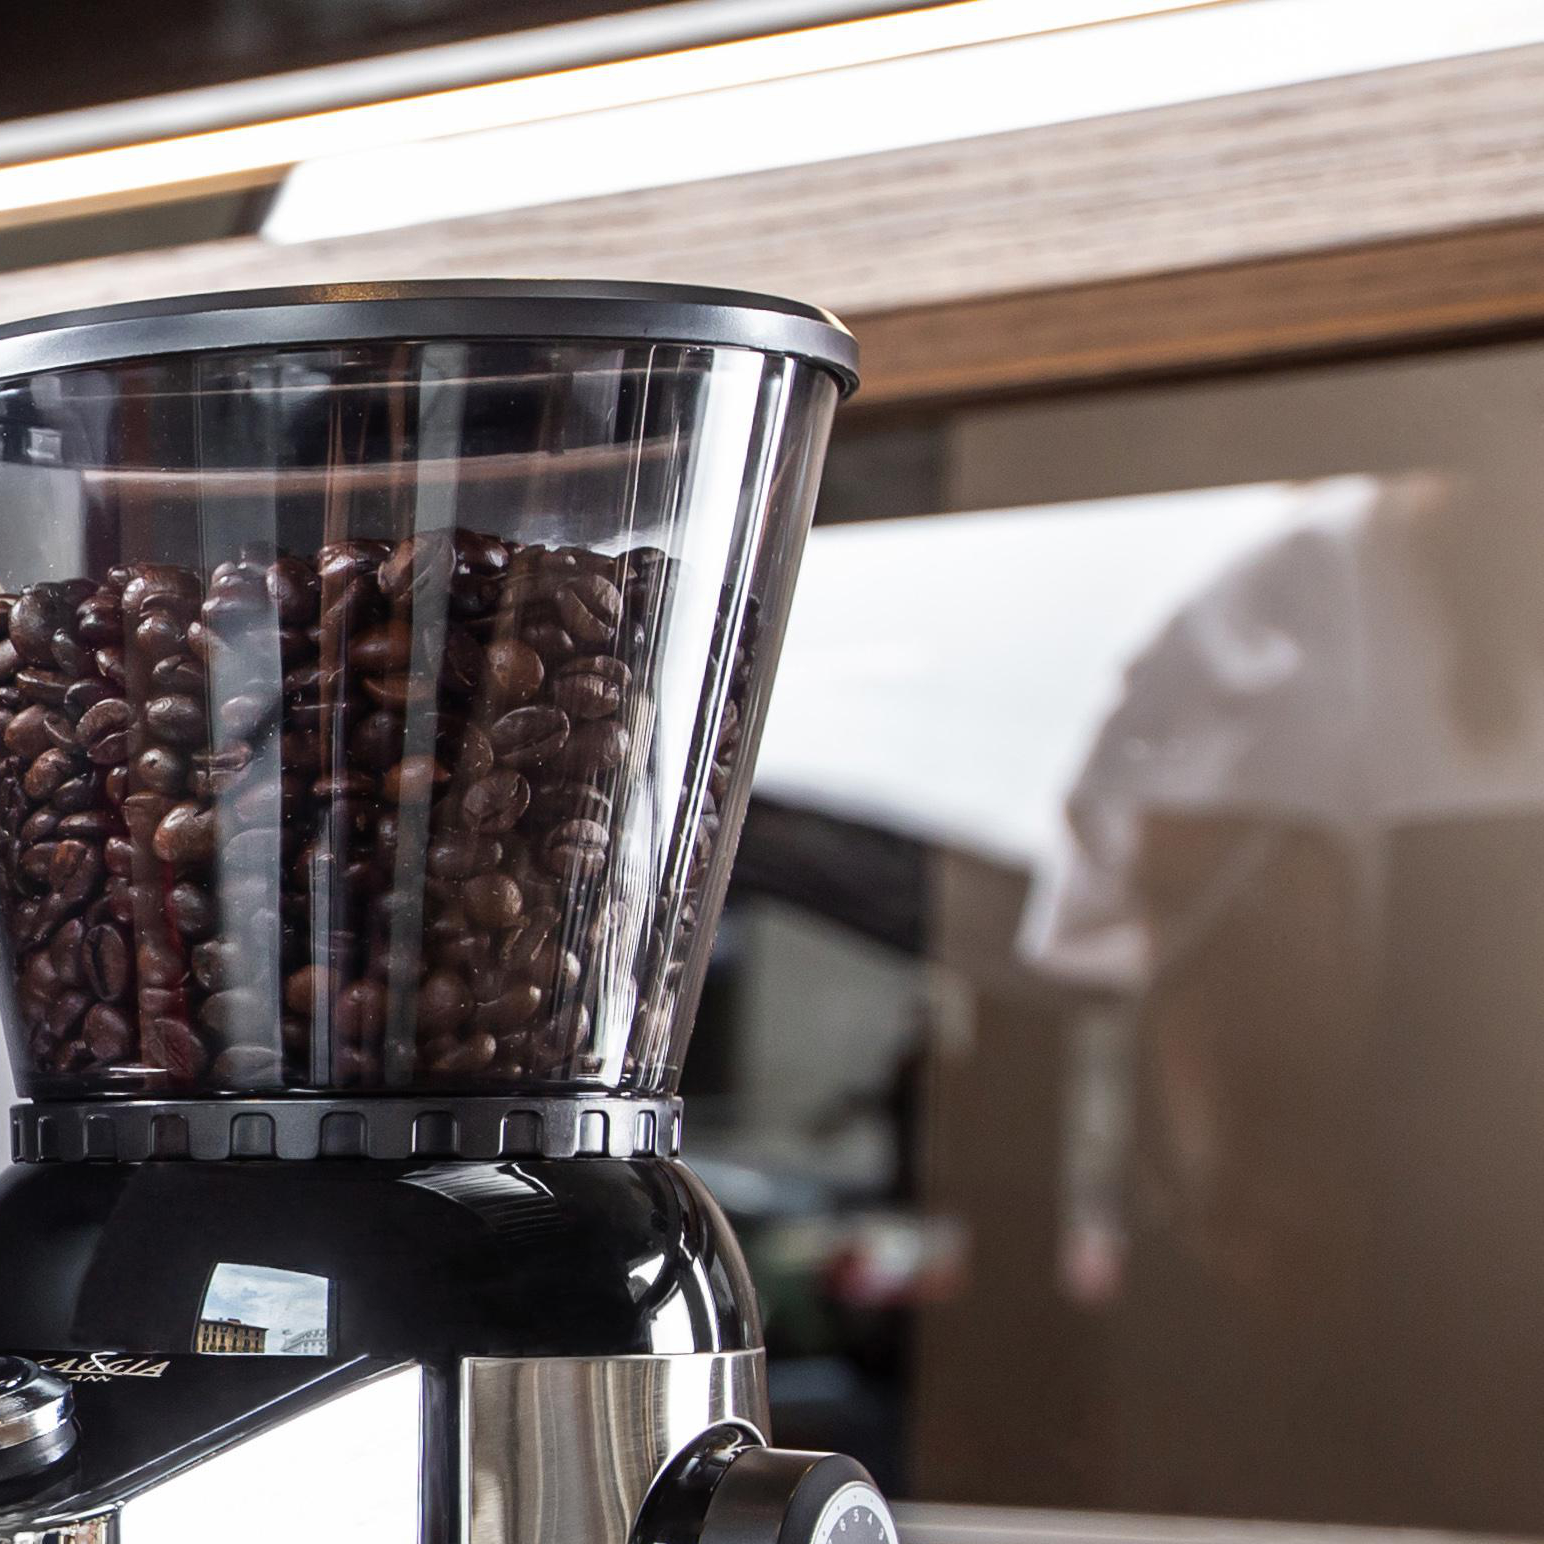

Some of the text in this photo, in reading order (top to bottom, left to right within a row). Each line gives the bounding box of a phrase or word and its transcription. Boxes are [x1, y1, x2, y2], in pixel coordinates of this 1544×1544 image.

[853, 1508, 860, 1522] 5
[867, 1512, 873, 1526] 4
[839, 1518, 846, 1531] 6
